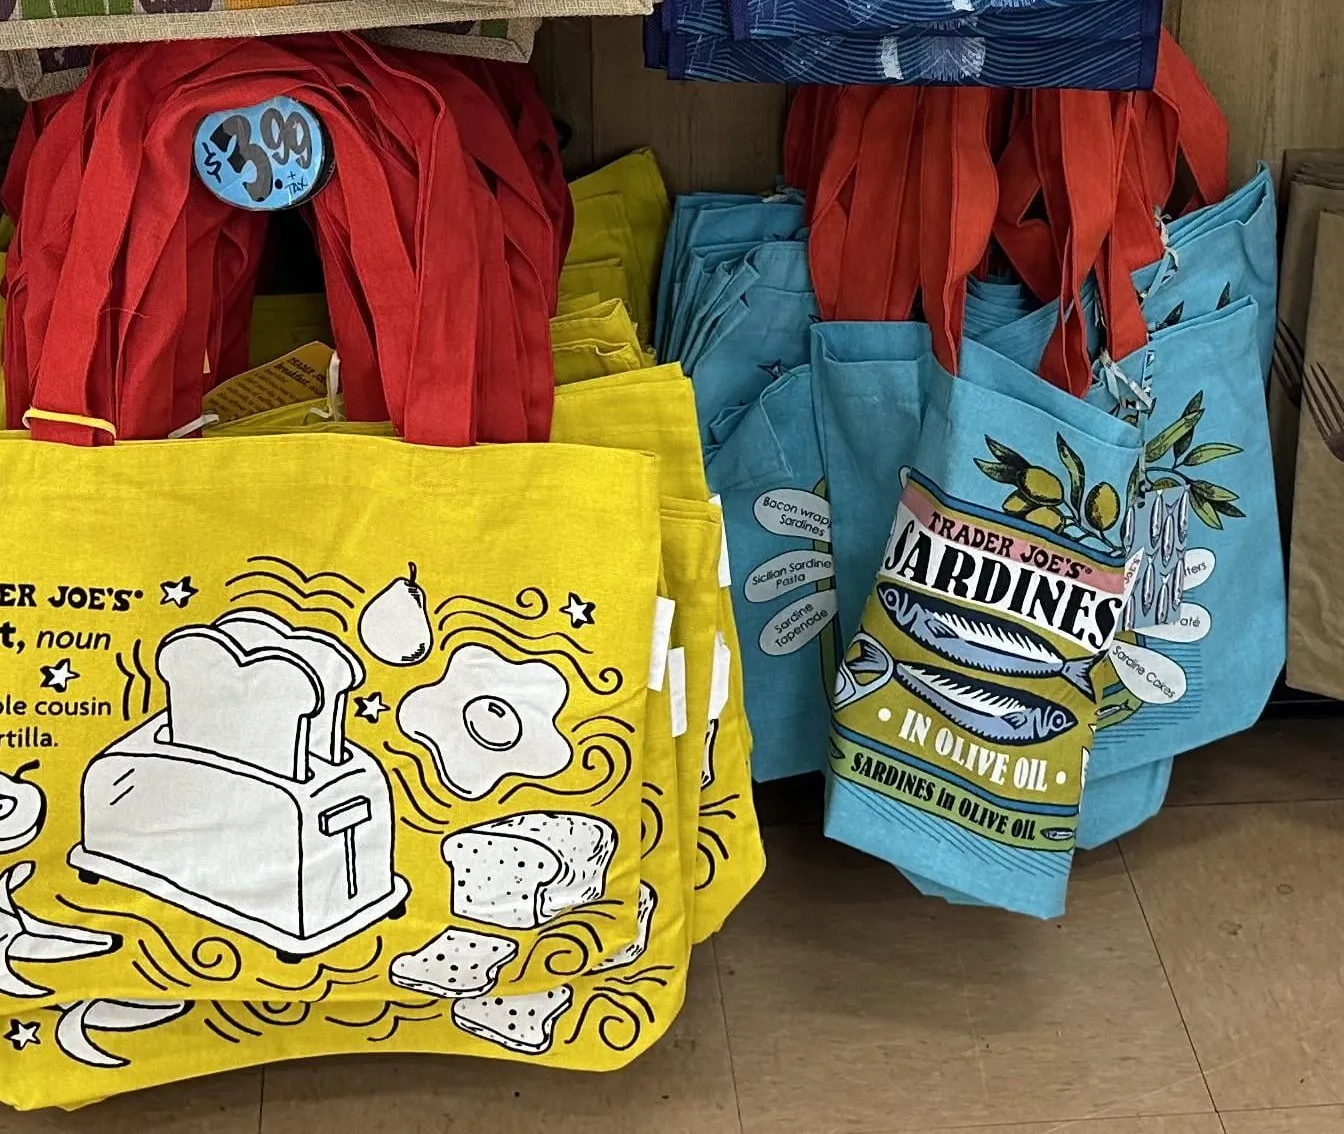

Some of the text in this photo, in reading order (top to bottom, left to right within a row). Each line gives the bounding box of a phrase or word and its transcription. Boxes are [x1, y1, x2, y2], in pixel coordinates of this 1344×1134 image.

[202, 107, 314, 202] $3.99
[763, 496, 797, 514] Bacon
[779, 514, 825, 536] Sardines
[928, 511, 1086, 580] TRADER JOE'S
[752, 559, 832, 586] Sicilian Sardine
[776, 573, 806, 589] Pasta
[885, 519, 1123, 650] SARDINES
[1183, 562, 1207, 578] tters
[47, 585, 138, 611] JOE'S
[774, 602, 814, 634] Sardine
[774, 609, 829, 648] Tapenade
[36, 628, 112, 651] noun
[1112, 645, 1176, 700] Sardine Cakes
[35, 698, 112, 716] cousin
[898, 708, 1048, 792] IN OLIVE OIL
[851, 752, 1035, 840] SARDINES in OLIVE OIL
